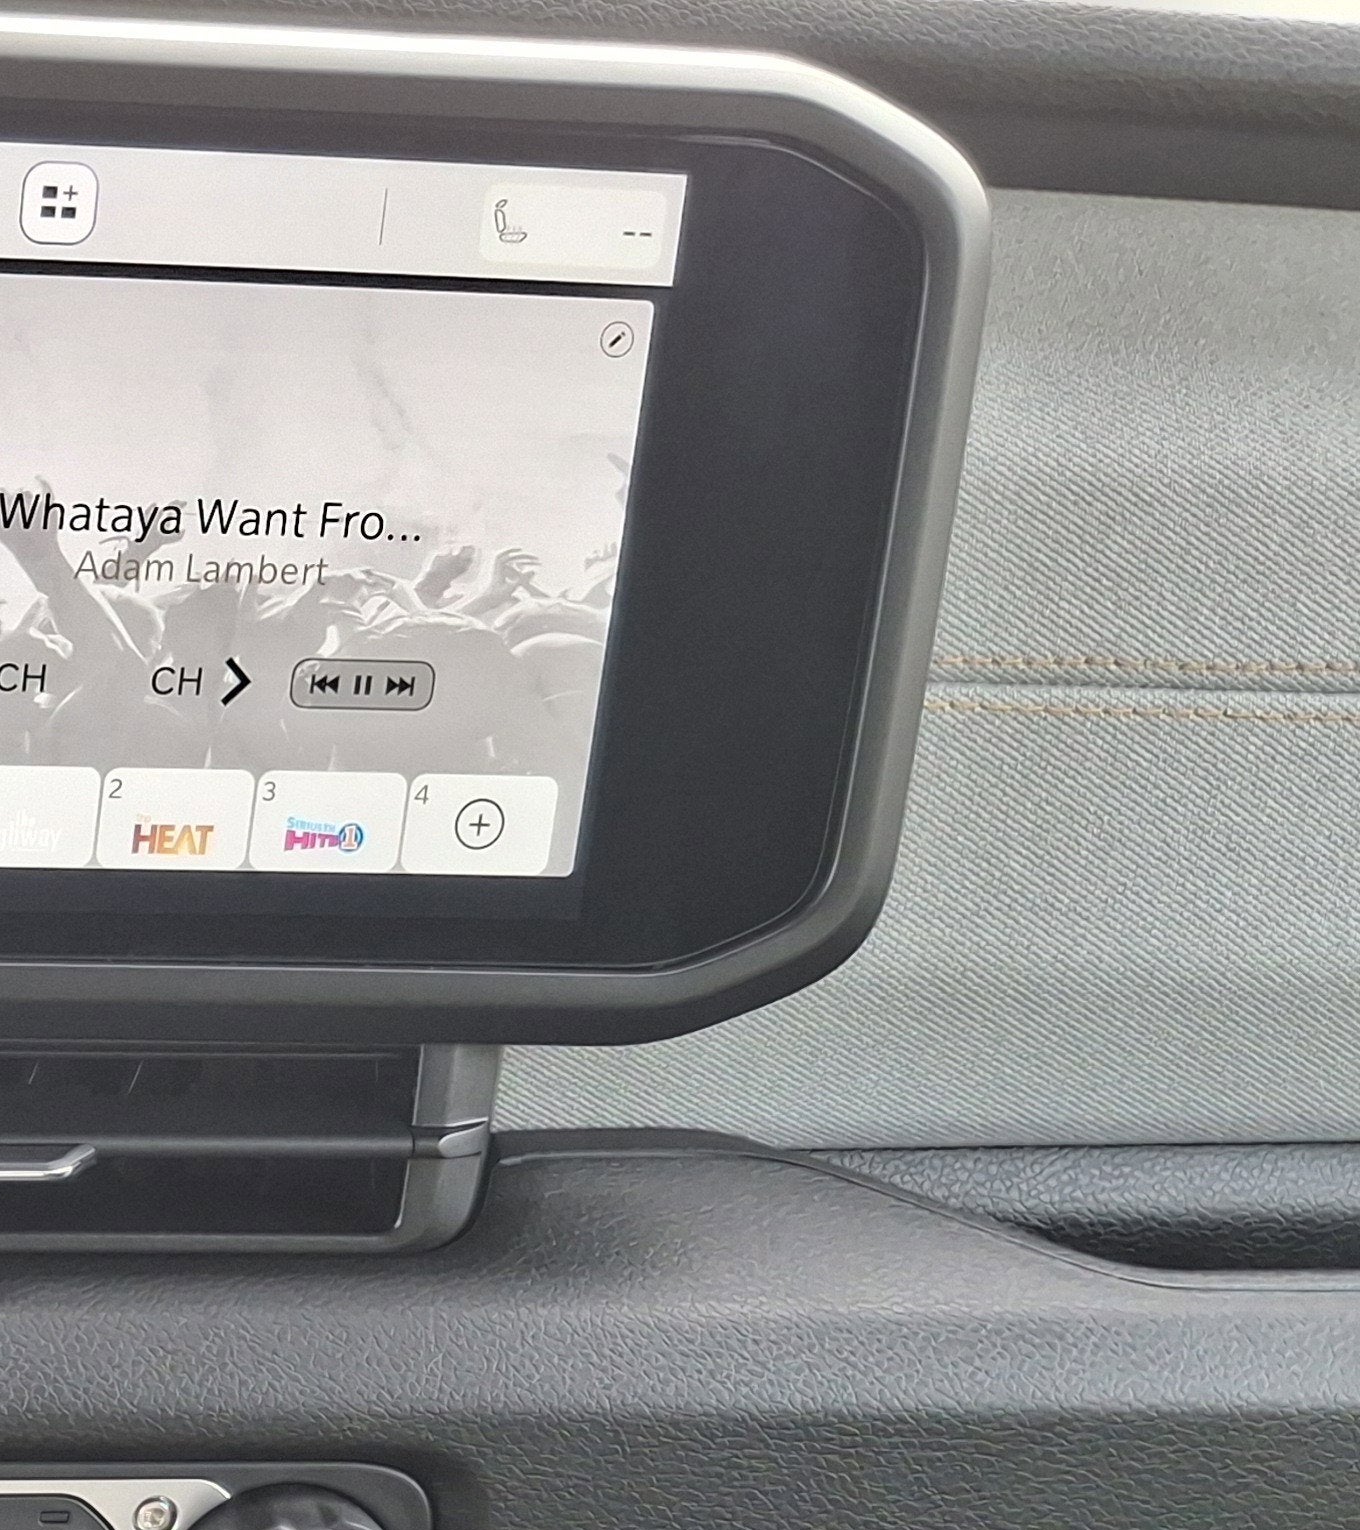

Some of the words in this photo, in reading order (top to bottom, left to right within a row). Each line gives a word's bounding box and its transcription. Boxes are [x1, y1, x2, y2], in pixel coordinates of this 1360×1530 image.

[197, 498, 307, 540] Want
[320, 503, 423, 544] Fro...
[75, 552, 174, 584] Adam
[186, 554, 328, 587] Lambert
[150, 665, 204, 697] CH
[108, 778, 123, 799] 2
[261, 781, 276, 801] 3
[414, 785, 429, 805] 4
[131, 824, 214, 855] HEAT
